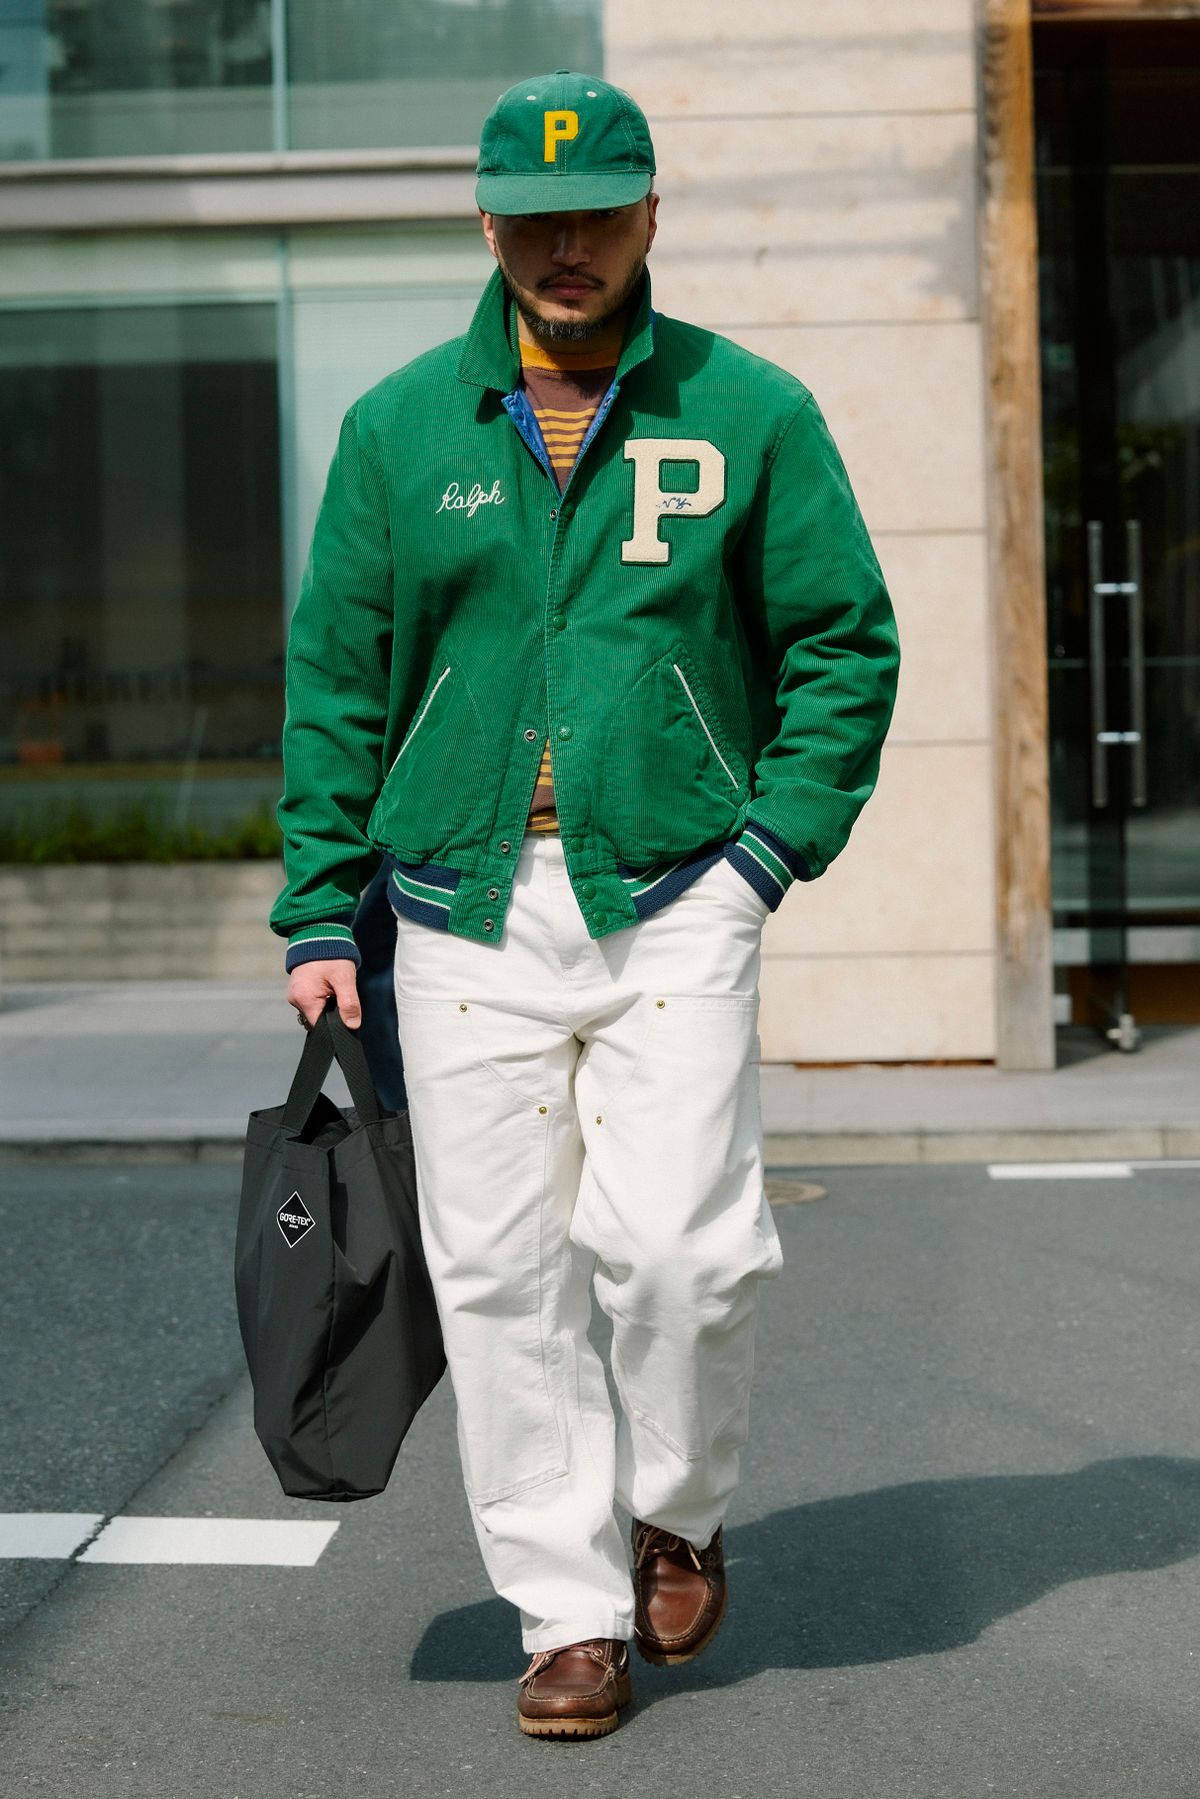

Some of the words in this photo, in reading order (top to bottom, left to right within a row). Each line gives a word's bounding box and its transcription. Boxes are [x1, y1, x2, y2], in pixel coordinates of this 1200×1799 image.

[544, 111, 579, 163] P
[435, 480, 506, 519] Ralph
[622, 438, 726, 565] P
